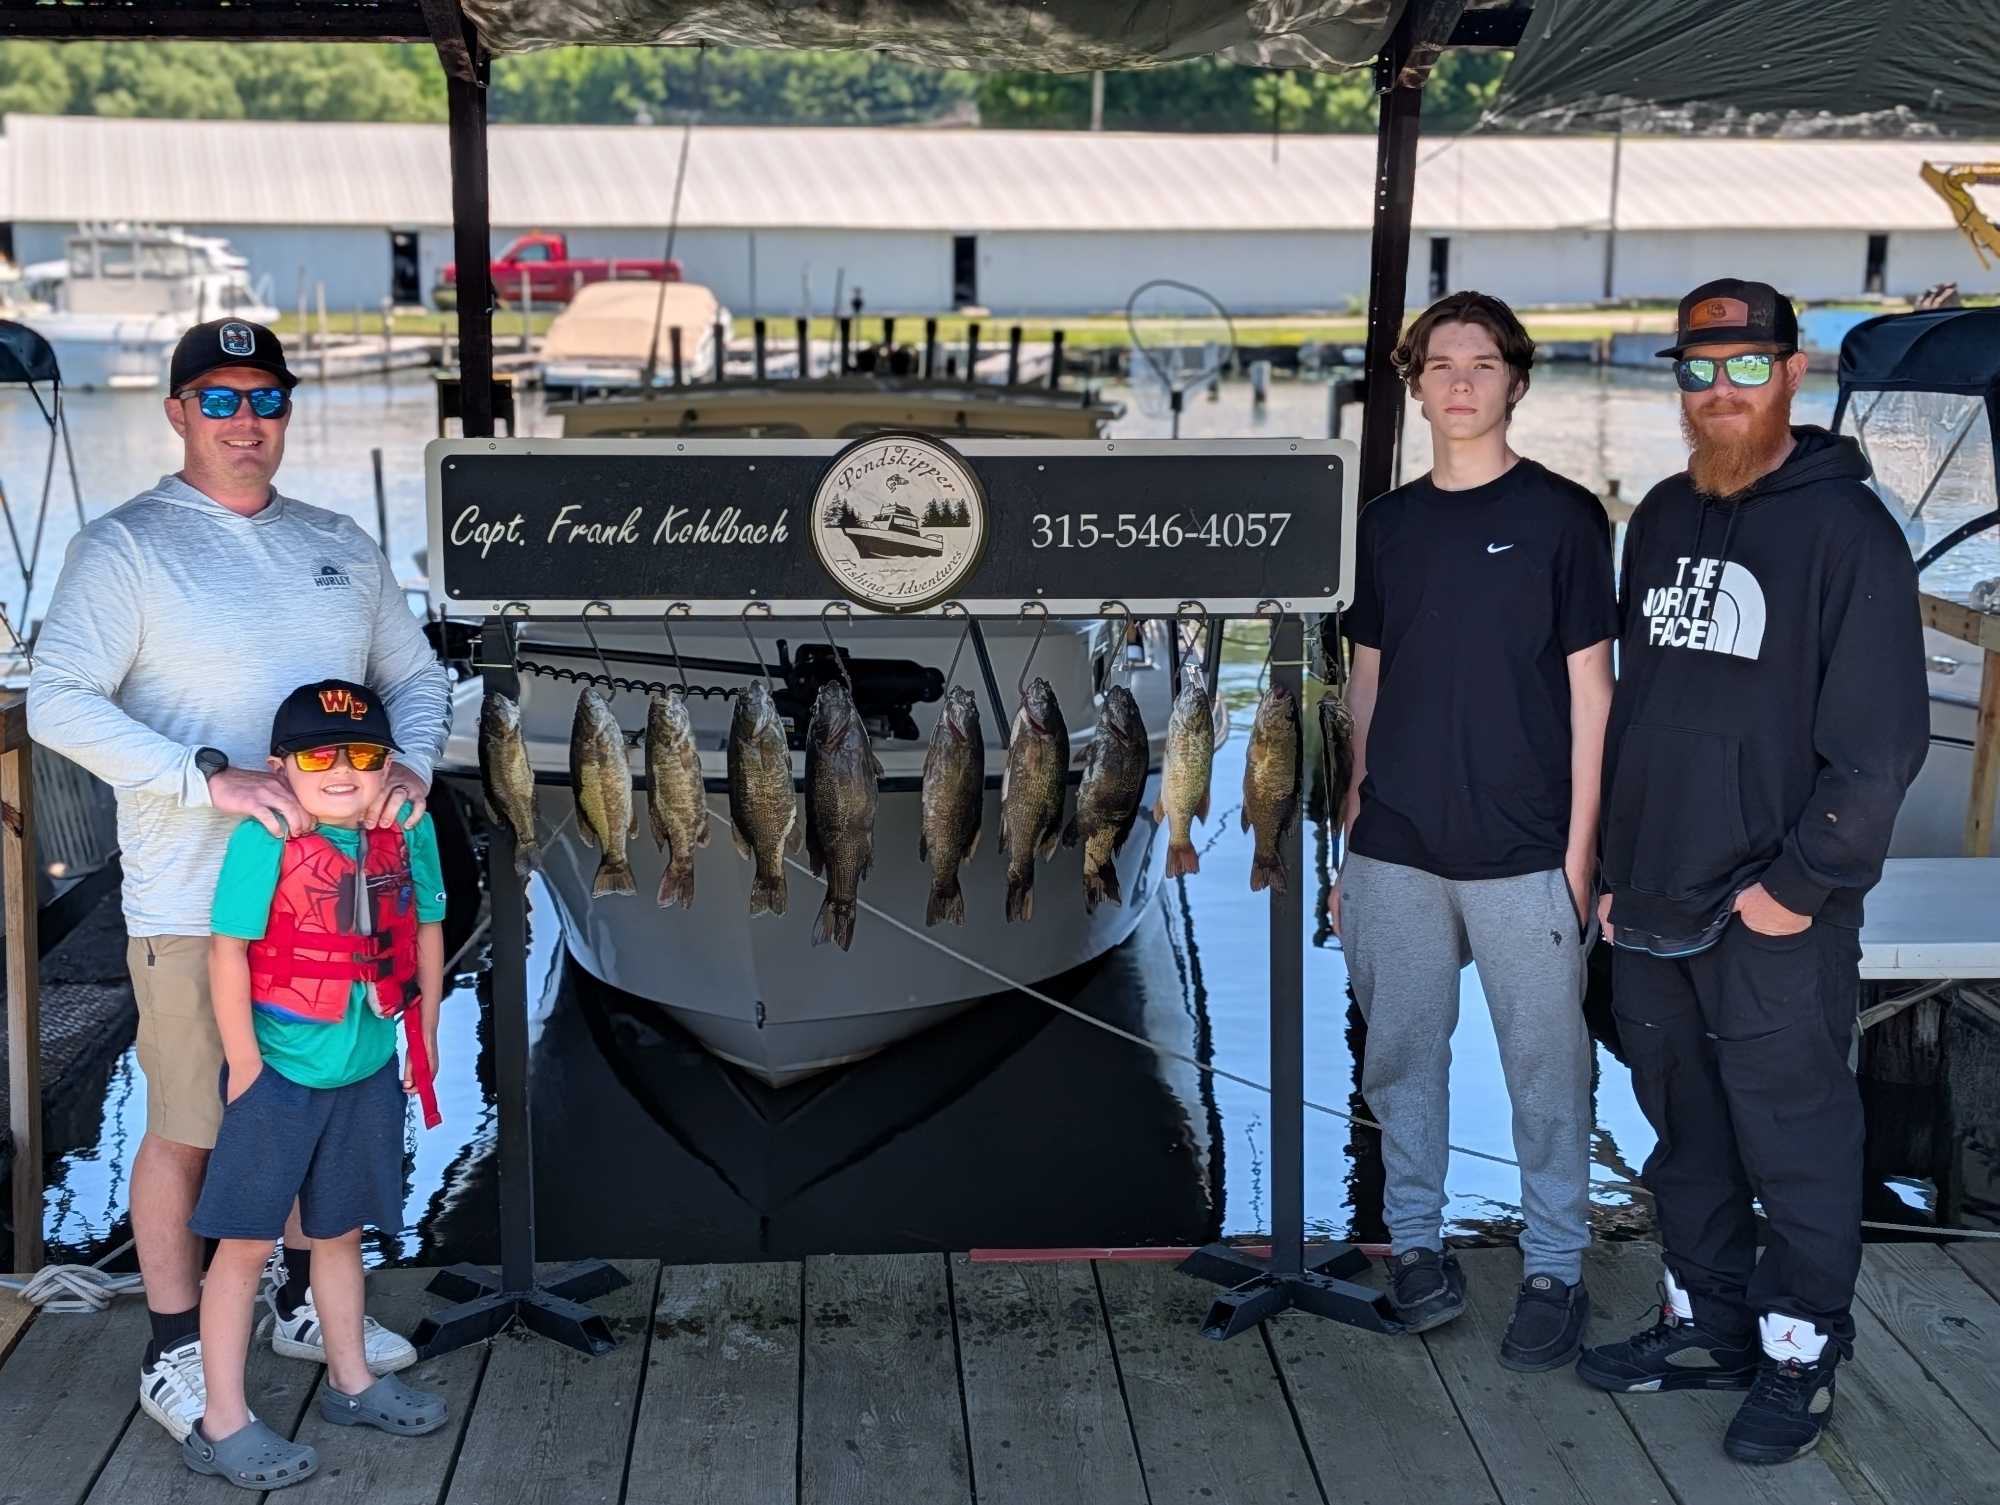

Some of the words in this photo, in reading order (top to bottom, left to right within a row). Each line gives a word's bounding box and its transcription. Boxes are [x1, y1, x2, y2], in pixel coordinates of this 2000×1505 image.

[838, 447, 956, 492] Pondskipper
[450, 504, 525, 559] Capt.
[547, 504, 643, 546] Frank
[1031, 513, 1292, 548] 315-546-4057
[313, 575, 352, 587] HURLEY
[835, 557, 886, 598] Fishing
[887, 549, 963, 596] Adventures
[1675, 557, 1720, 589] THE
[1649, 616, 1709, 650] FACE
